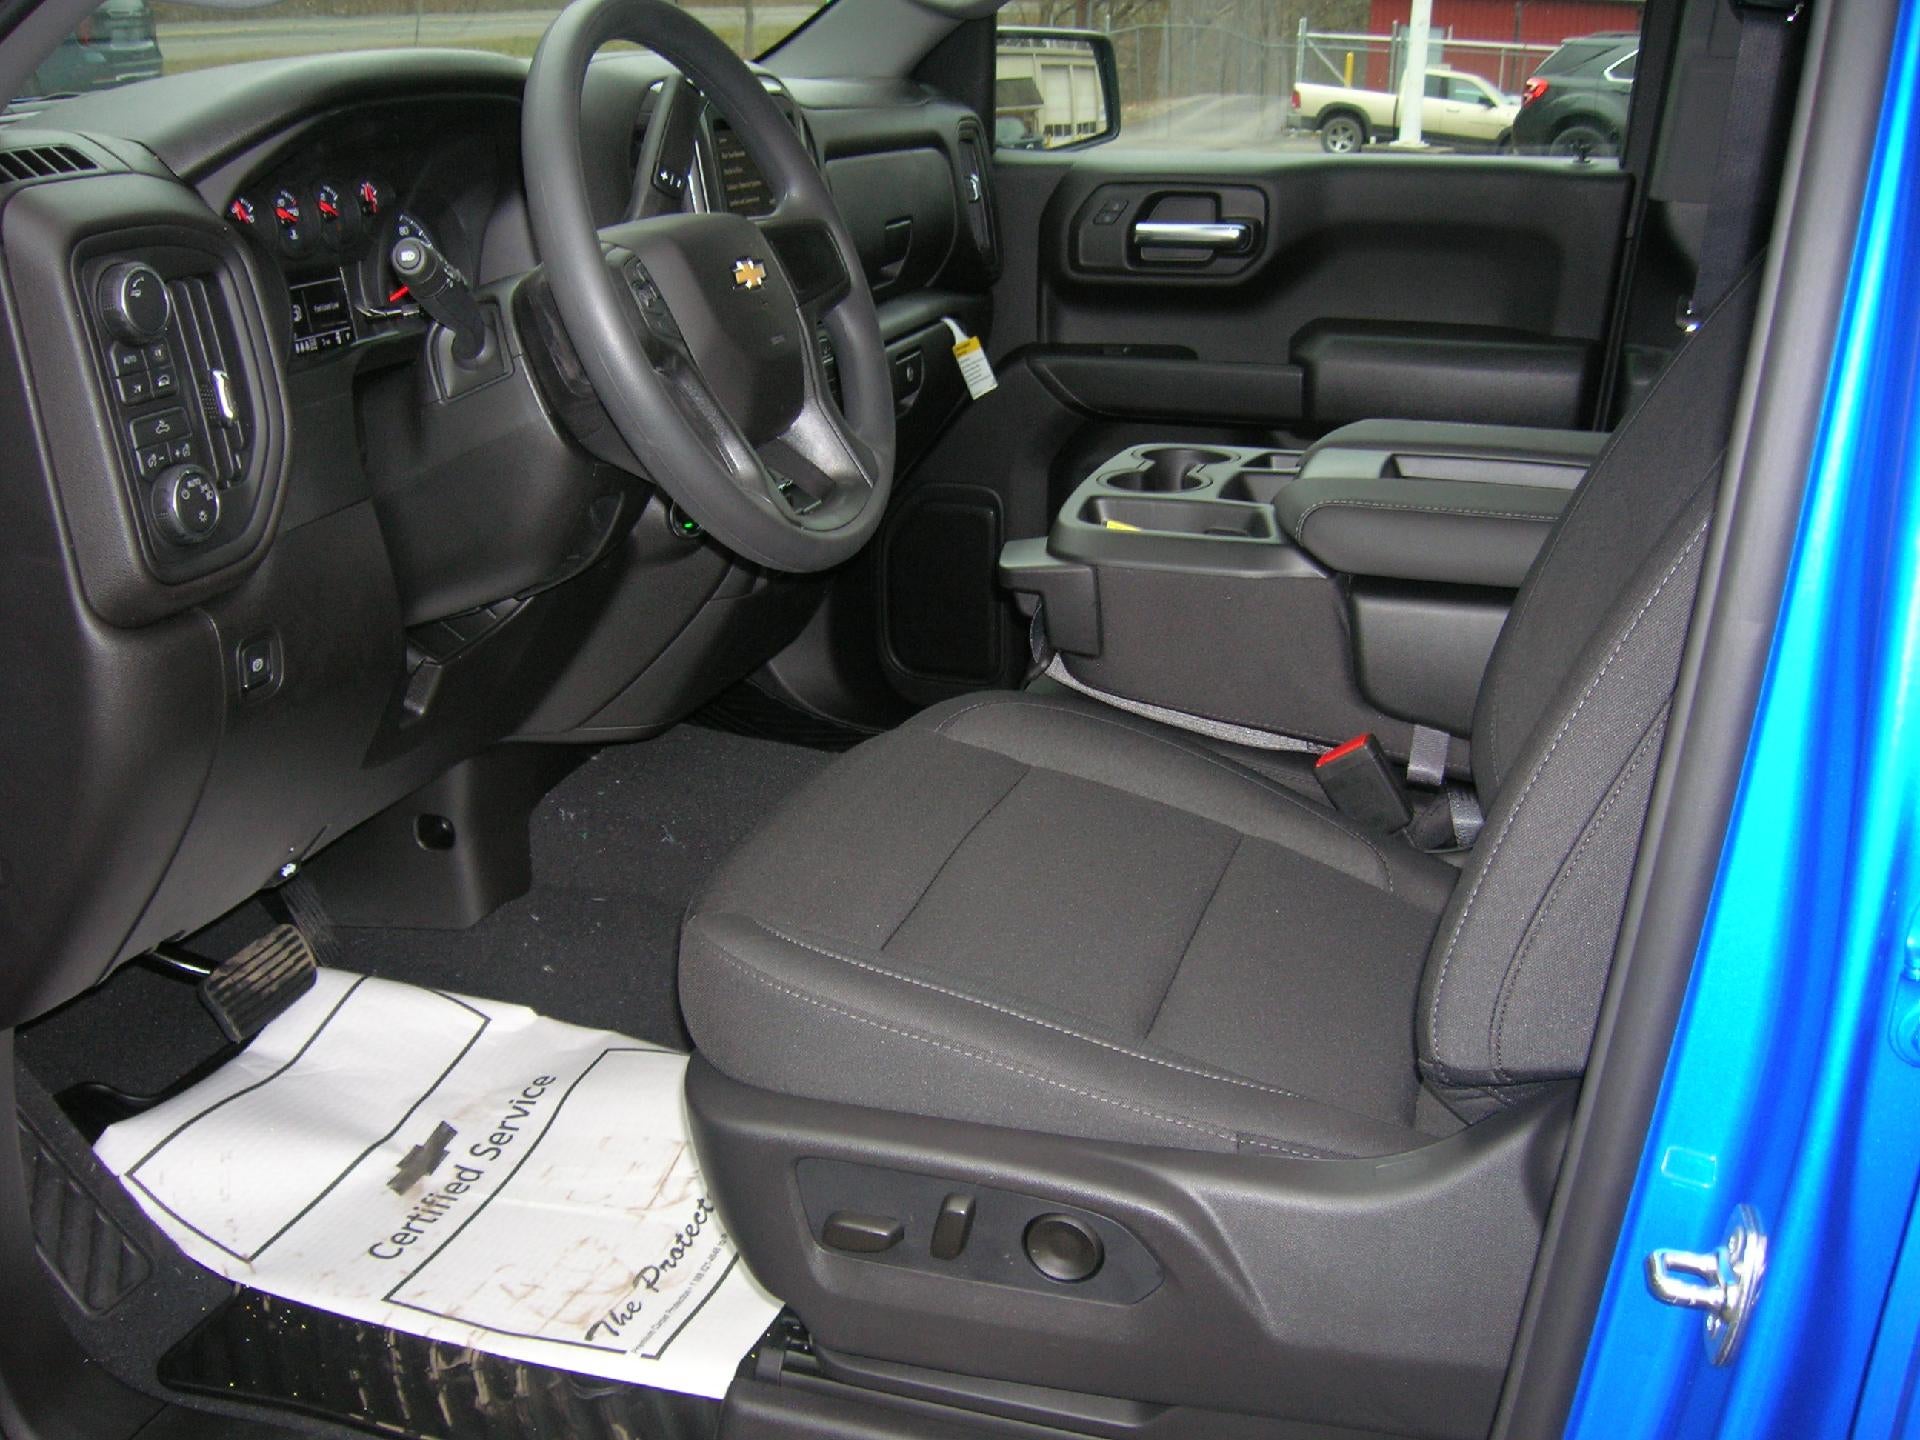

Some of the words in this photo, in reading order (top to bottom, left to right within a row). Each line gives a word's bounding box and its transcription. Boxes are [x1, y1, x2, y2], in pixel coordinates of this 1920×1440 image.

[368, 1163, 485, 1260] Certified
[469, 1074, 557, 1161] Service
[584, 1300, 642, 1341] The
[632, 1193, 714, 1293] Protect
